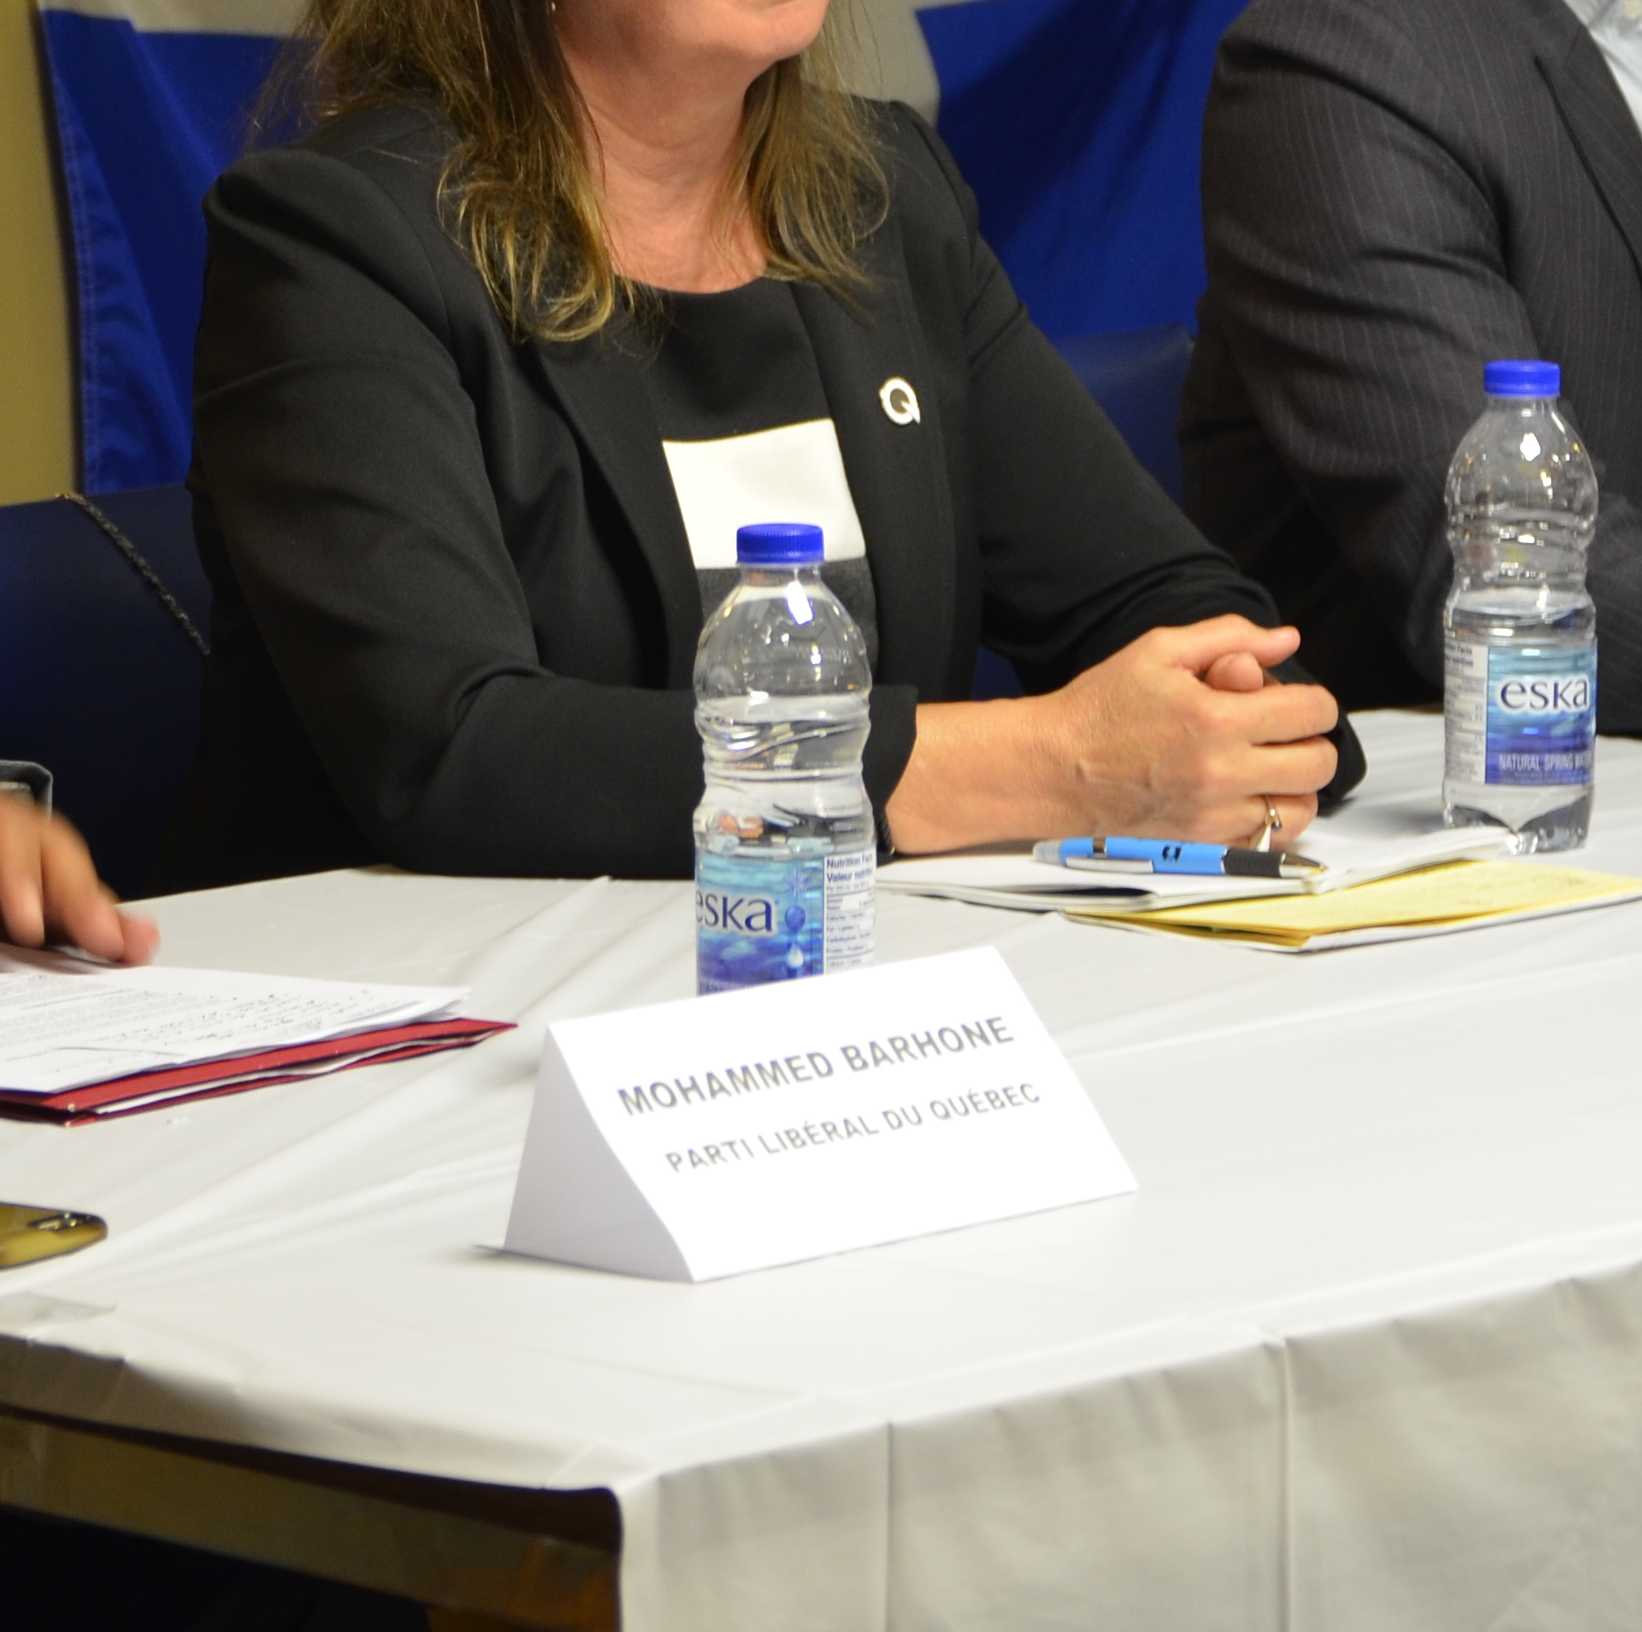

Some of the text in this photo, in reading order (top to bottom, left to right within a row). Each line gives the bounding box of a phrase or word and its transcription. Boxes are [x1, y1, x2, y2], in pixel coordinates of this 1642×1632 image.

[1500, 678, 1588, 710] eska
[1499, 754, 1540, 771] NATURAL
[616, 1016, 1014, 1116] MOHAMMED BARHONE
[664, 1082, 1041, 1173] PARTI LIBÉRAL DU QUÉBEC
